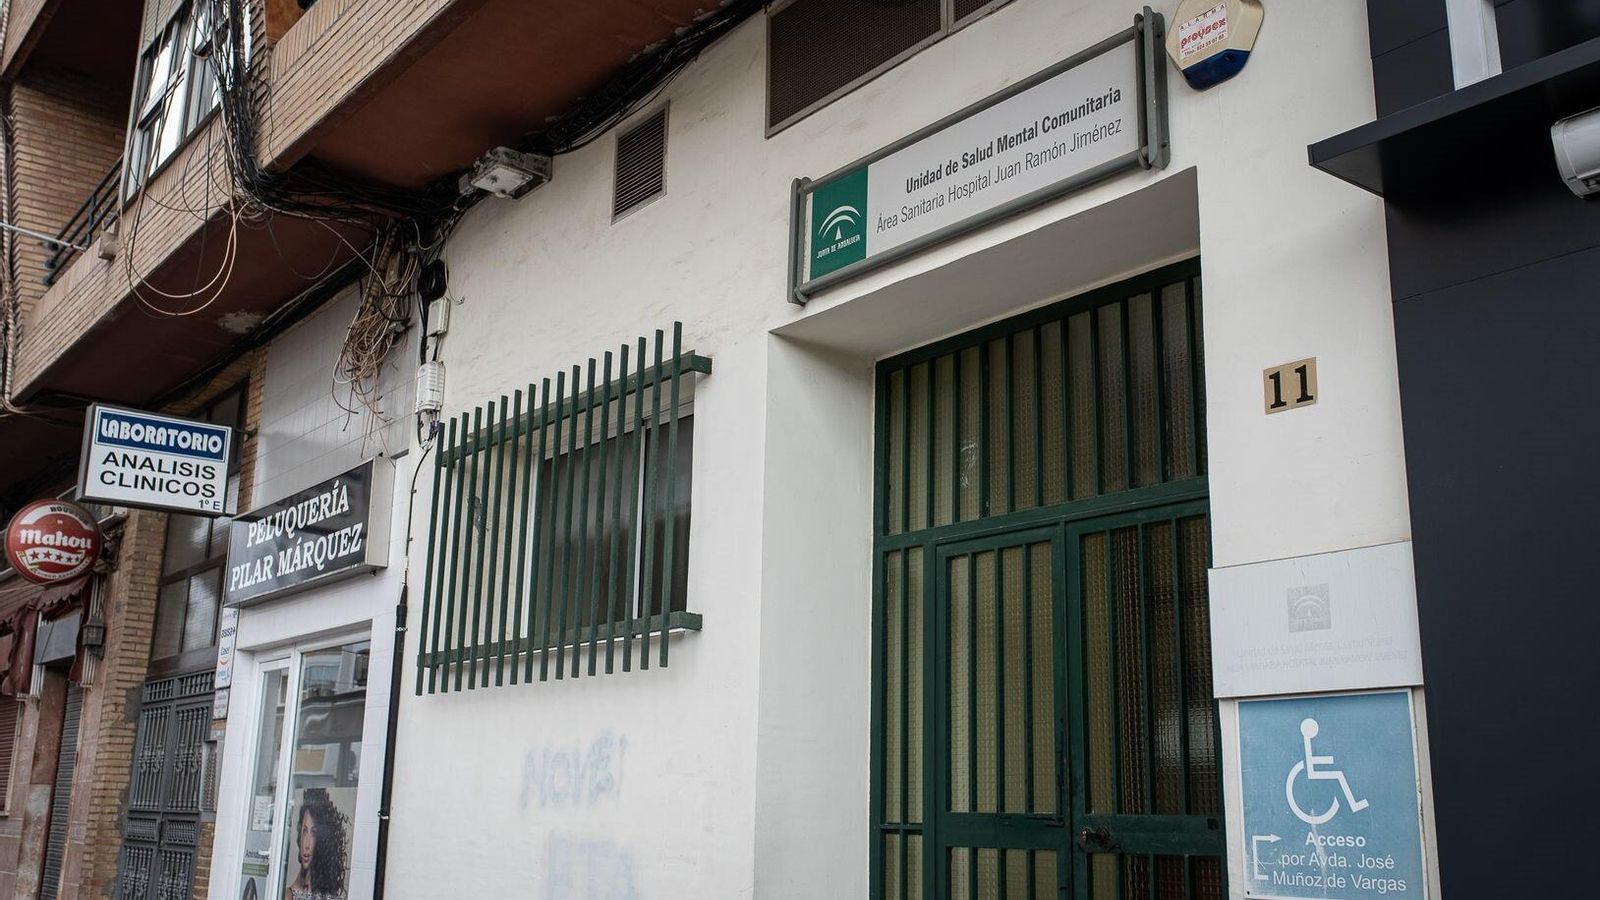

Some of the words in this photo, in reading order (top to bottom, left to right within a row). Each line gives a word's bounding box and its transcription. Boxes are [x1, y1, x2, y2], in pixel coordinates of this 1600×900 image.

[905, 164, 944, 194] Unidad
[944, 158, 959, 176] de
[962, 140, 994, 169] Salud
[996, 121, 1039, 156] Mental
[1041, 87, 1121, 134] Comunitaria
[876, 212, 898, 235] Área
[901, 193, 944, 225] Sanitaria
[948, 170, 991, 203] Hospital
[994, 162, 1021, 184] Juan
[1025, 142, 1066, 172] Ramón
[1070, 118, 1122, 154] Jiménez
[816, 248, 830, 258] JUNTA
[830, 244, 837, 253] DE
[1268, 364, 1314, 410] 11
[100, 418, 223, 454] LABORATORIO
[102, 451, 216, 480] ANALISIS
[100, 470, 216, 498] CLINICOS
[212, 500, 221, 511] E
[246, 480, 349, 548] PELUQUERÍA
[20, 528, 92, 550] Mahou
[230, 555, 274, 592] PILAR
[278, 522, 363, 576] MÁRQUEZ
[1305, 832, 1366, 848] Acceso
[1282, 854, 1304, 869] por
[1308, 852, 1351, 869] Avda.
[1356, 854, 1395, 869] José
[1273, 871, 1322, 888] Muñoz
[1327, 872, 1346, 888] de
[1350, 874, 1407, 895] Vargas
